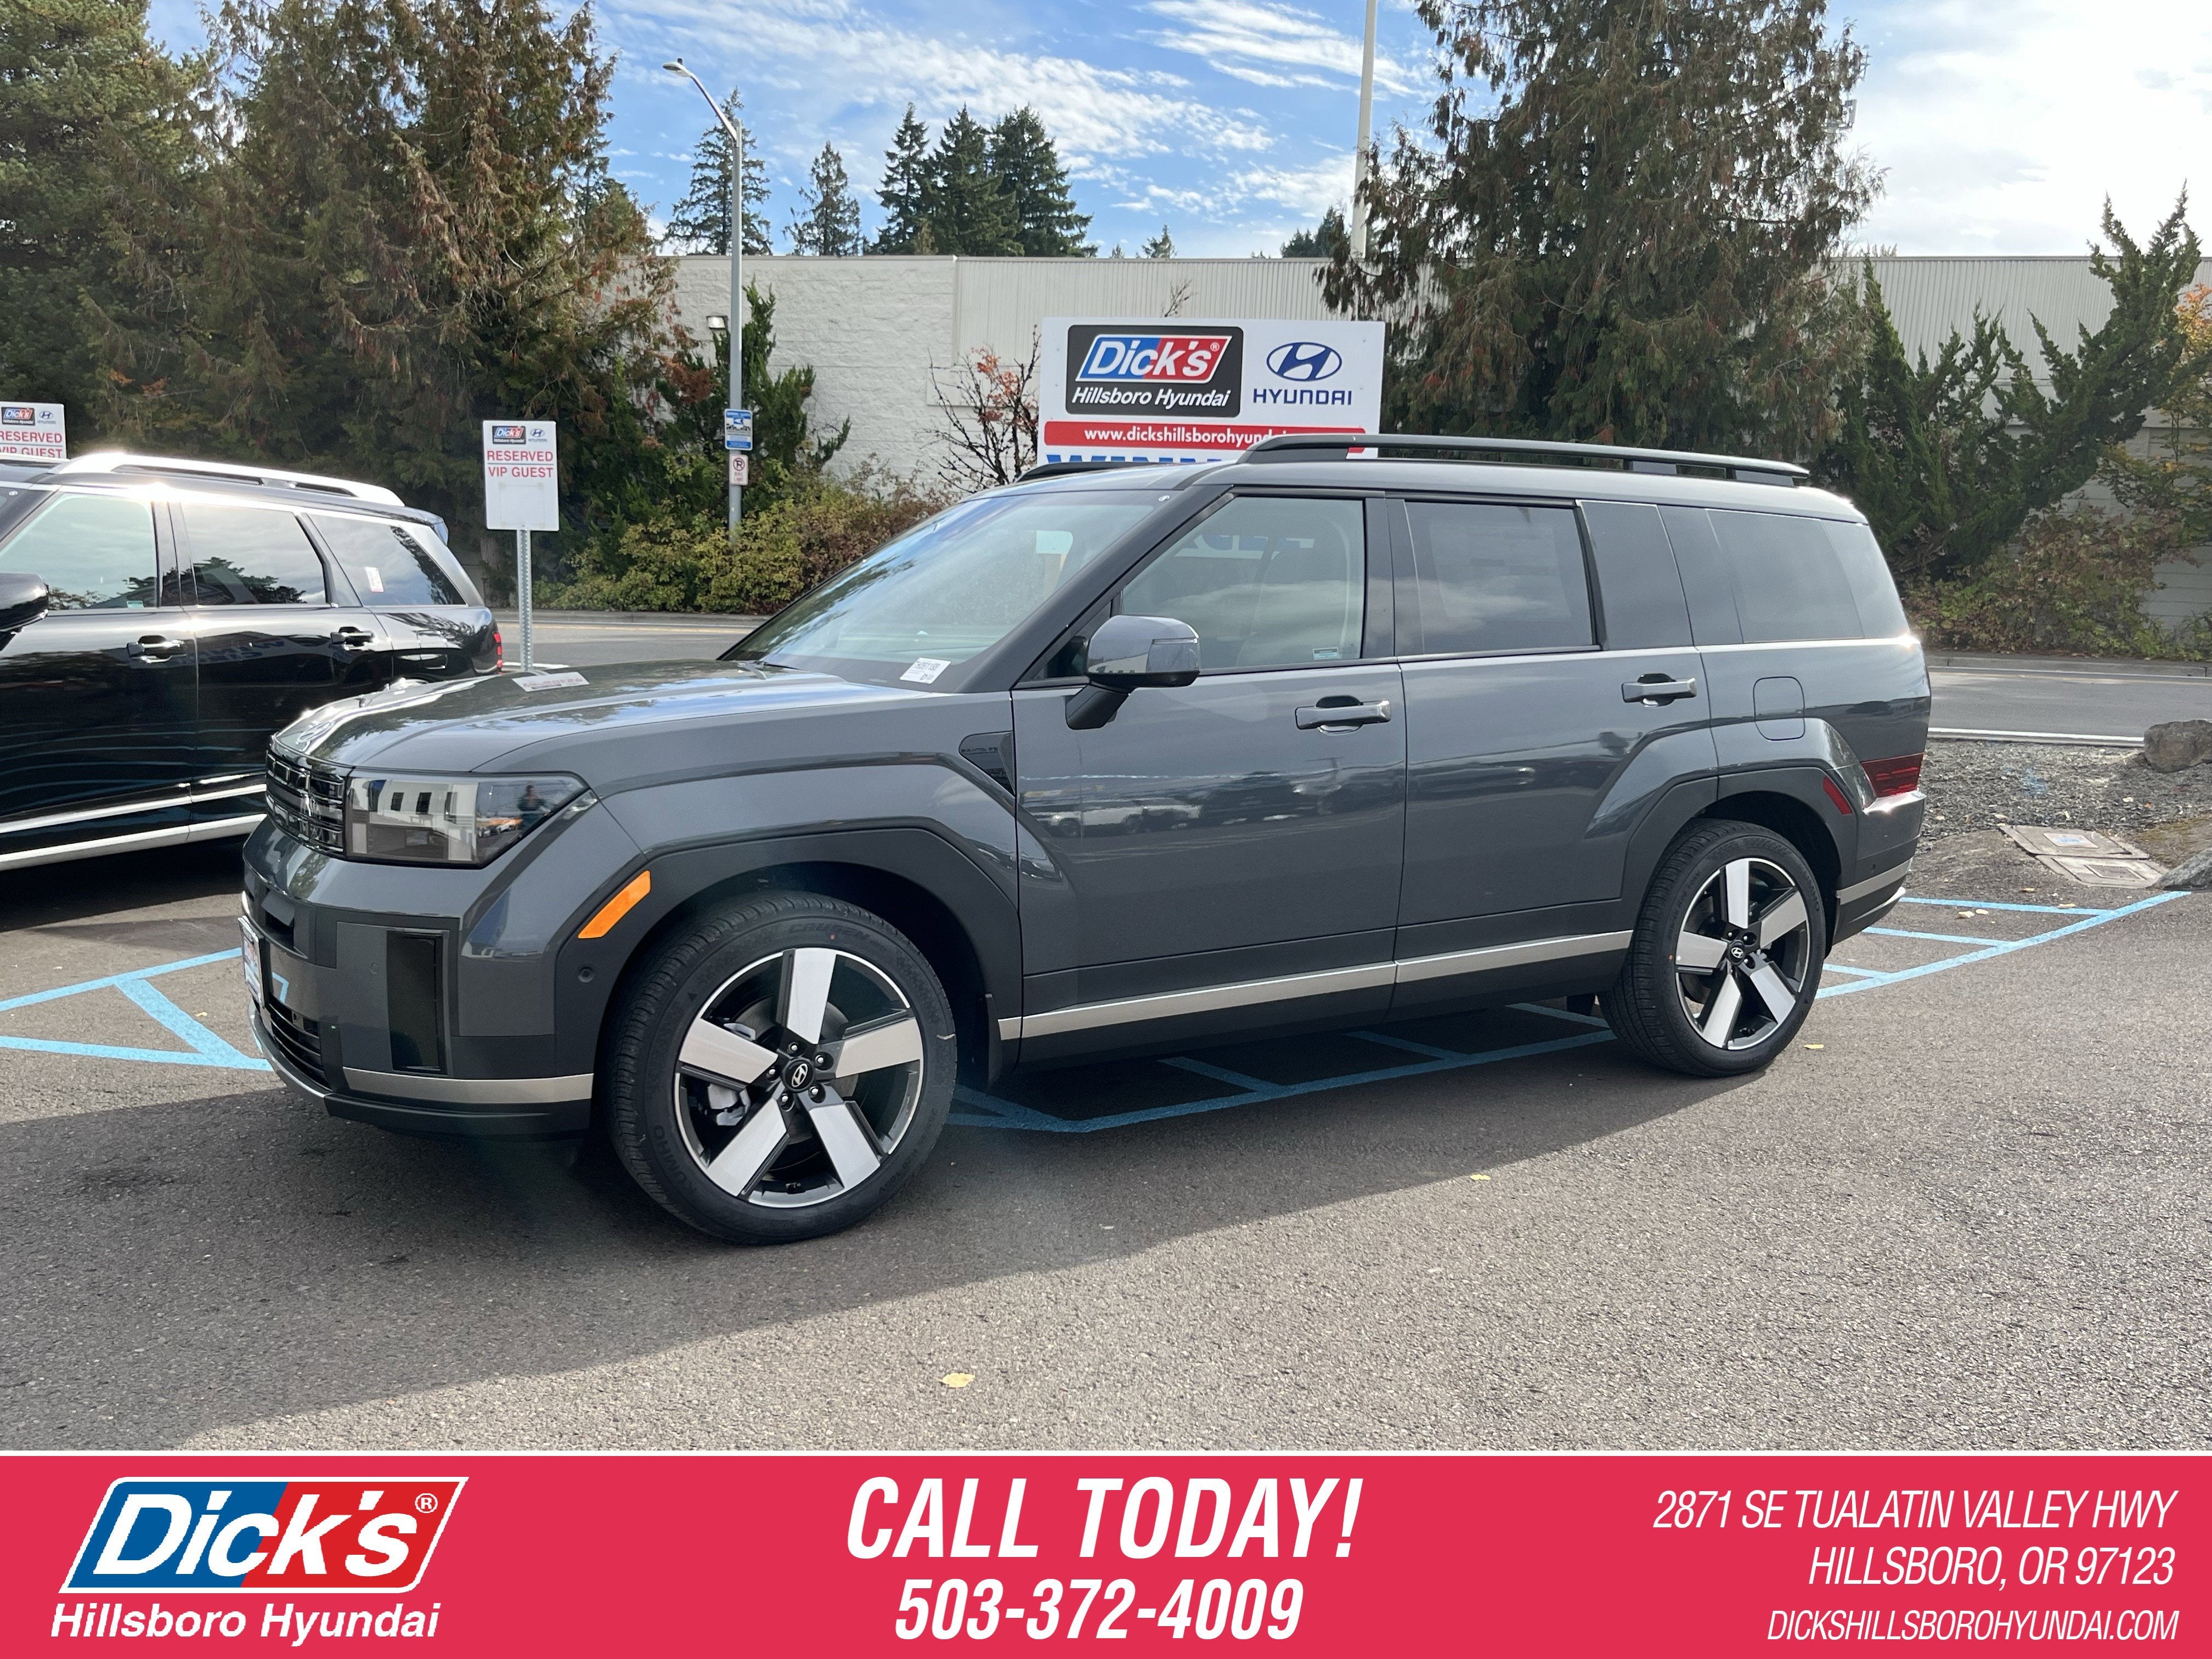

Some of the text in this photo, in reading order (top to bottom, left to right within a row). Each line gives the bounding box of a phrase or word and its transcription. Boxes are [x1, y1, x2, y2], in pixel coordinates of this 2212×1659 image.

[1088, 339, 1212, 377] Dick's
[1072, 387, 1231, 410] Hillsboro Hyundai
[1253, 388, 1352, 405] HYUNDAI
[21, 447, 63, 458] GUEST
[487, 450, 554, 461] RESERVED
[488, 467, 554, 477] VIP GUEST
